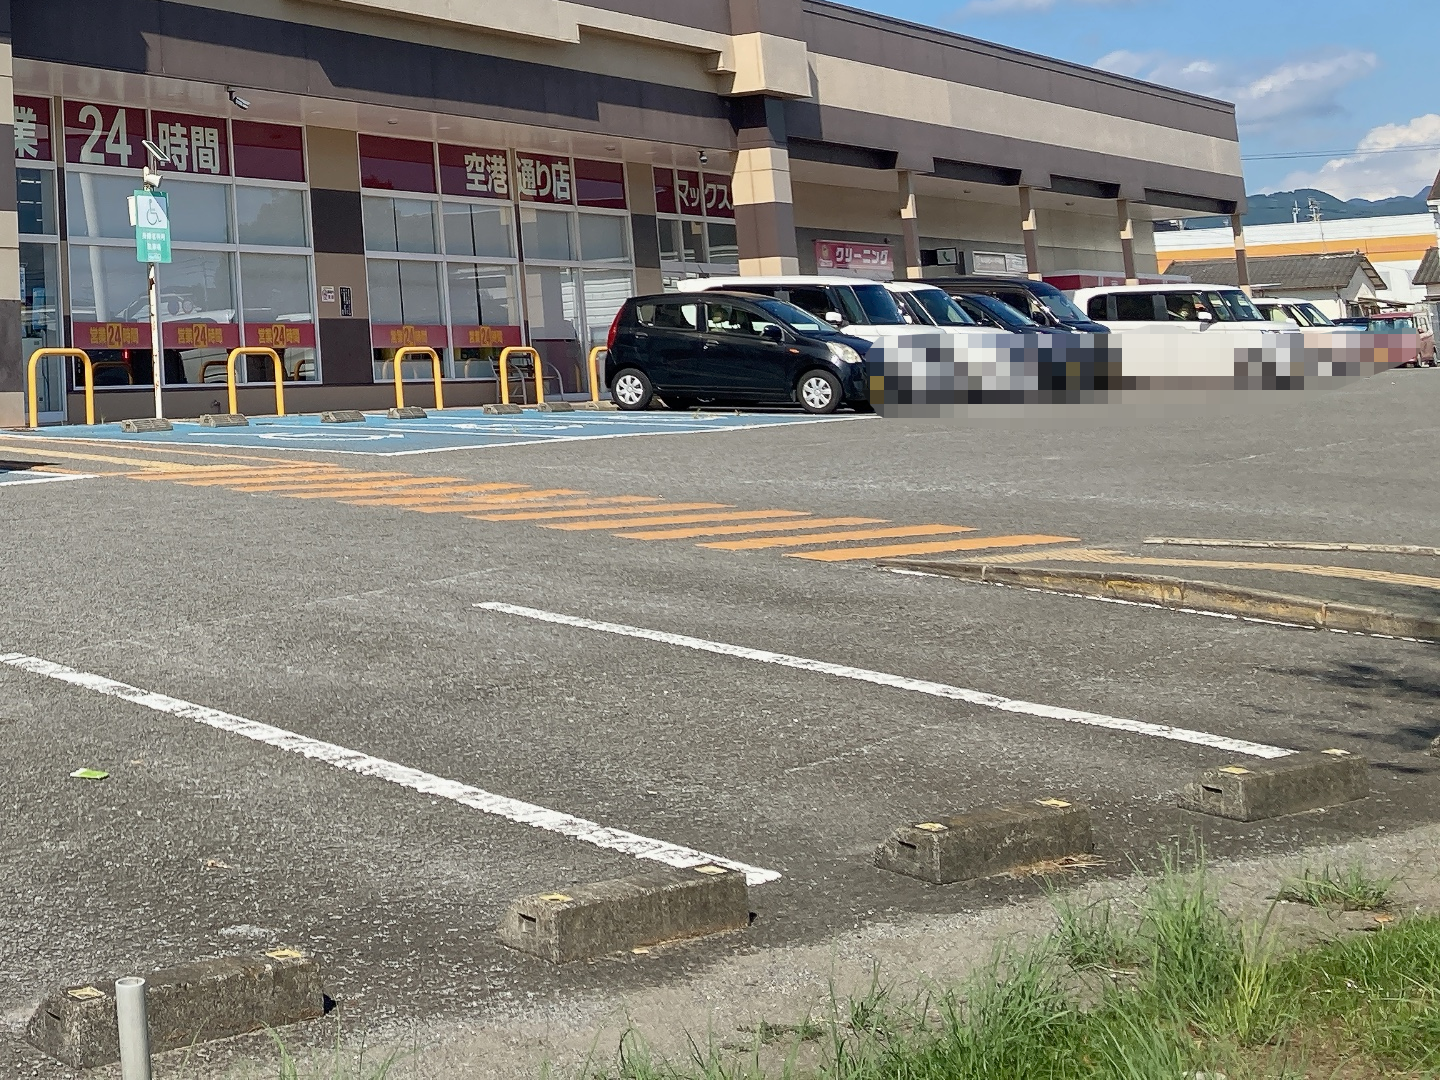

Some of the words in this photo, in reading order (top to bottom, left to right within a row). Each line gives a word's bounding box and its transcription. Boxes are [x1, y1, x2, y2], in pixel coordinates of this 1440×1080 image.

[464, 152, 571, 201] 空港通り店
[677, 179, 734, 210] マックス
[836, 247, 889, 265] クリーニング
